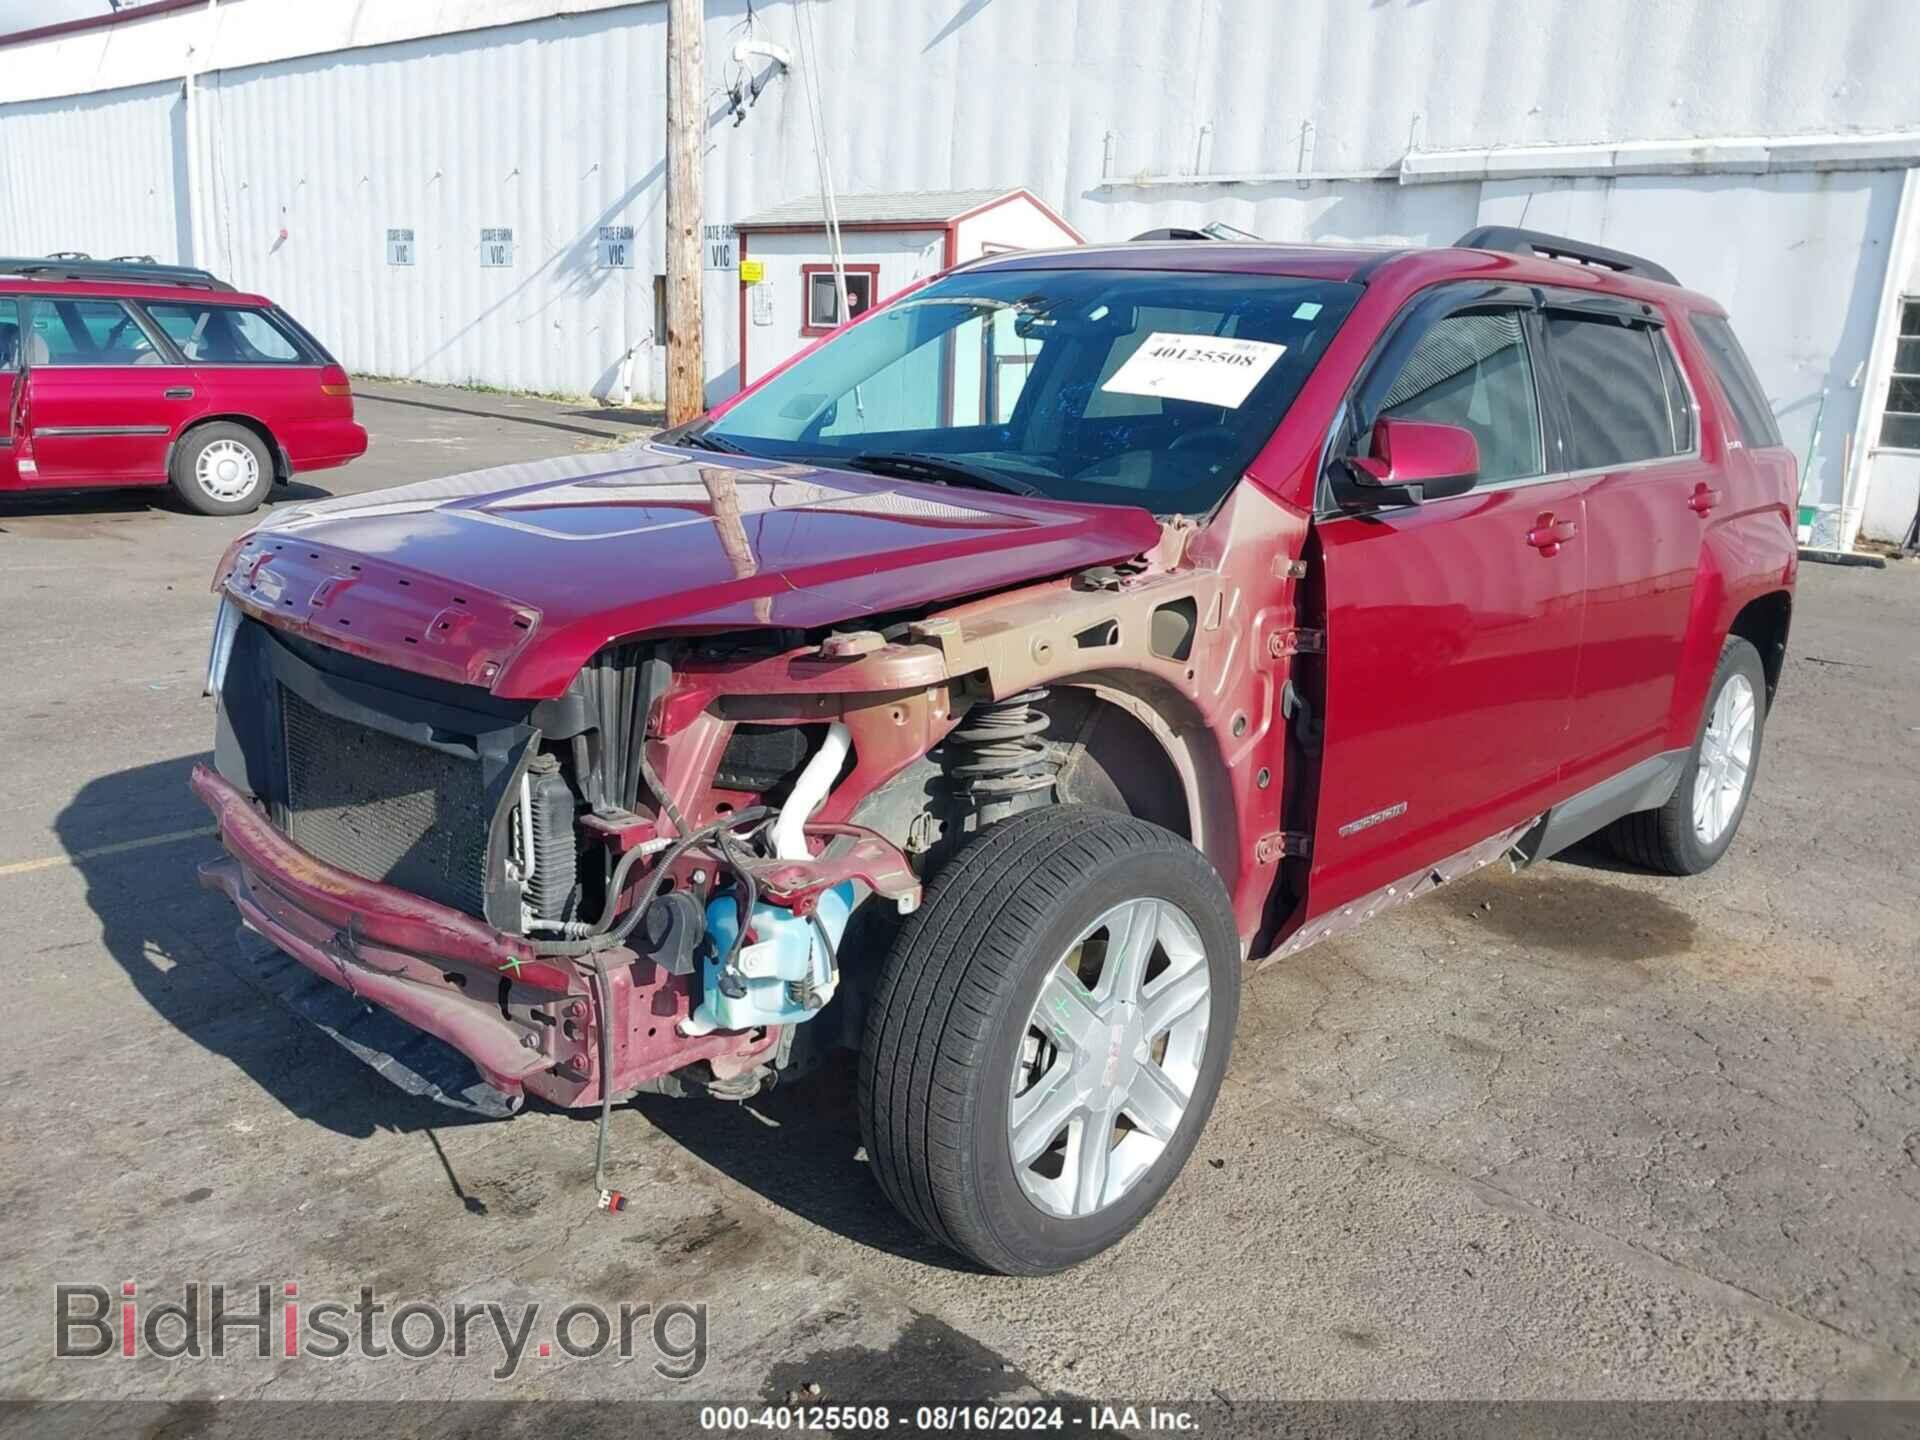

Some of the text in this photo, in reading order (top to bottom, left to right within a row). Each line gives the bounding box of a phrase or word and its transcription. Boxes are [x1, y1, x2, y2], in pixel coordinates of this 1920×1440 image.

[704, 226, 720, 240] TATE
[490, 246, 504, 264] VIC
[608, 245, 624, 265] VIC
[712, 245, 729, 267] VIC
[1150, 347, 1256, 367] 40125508
